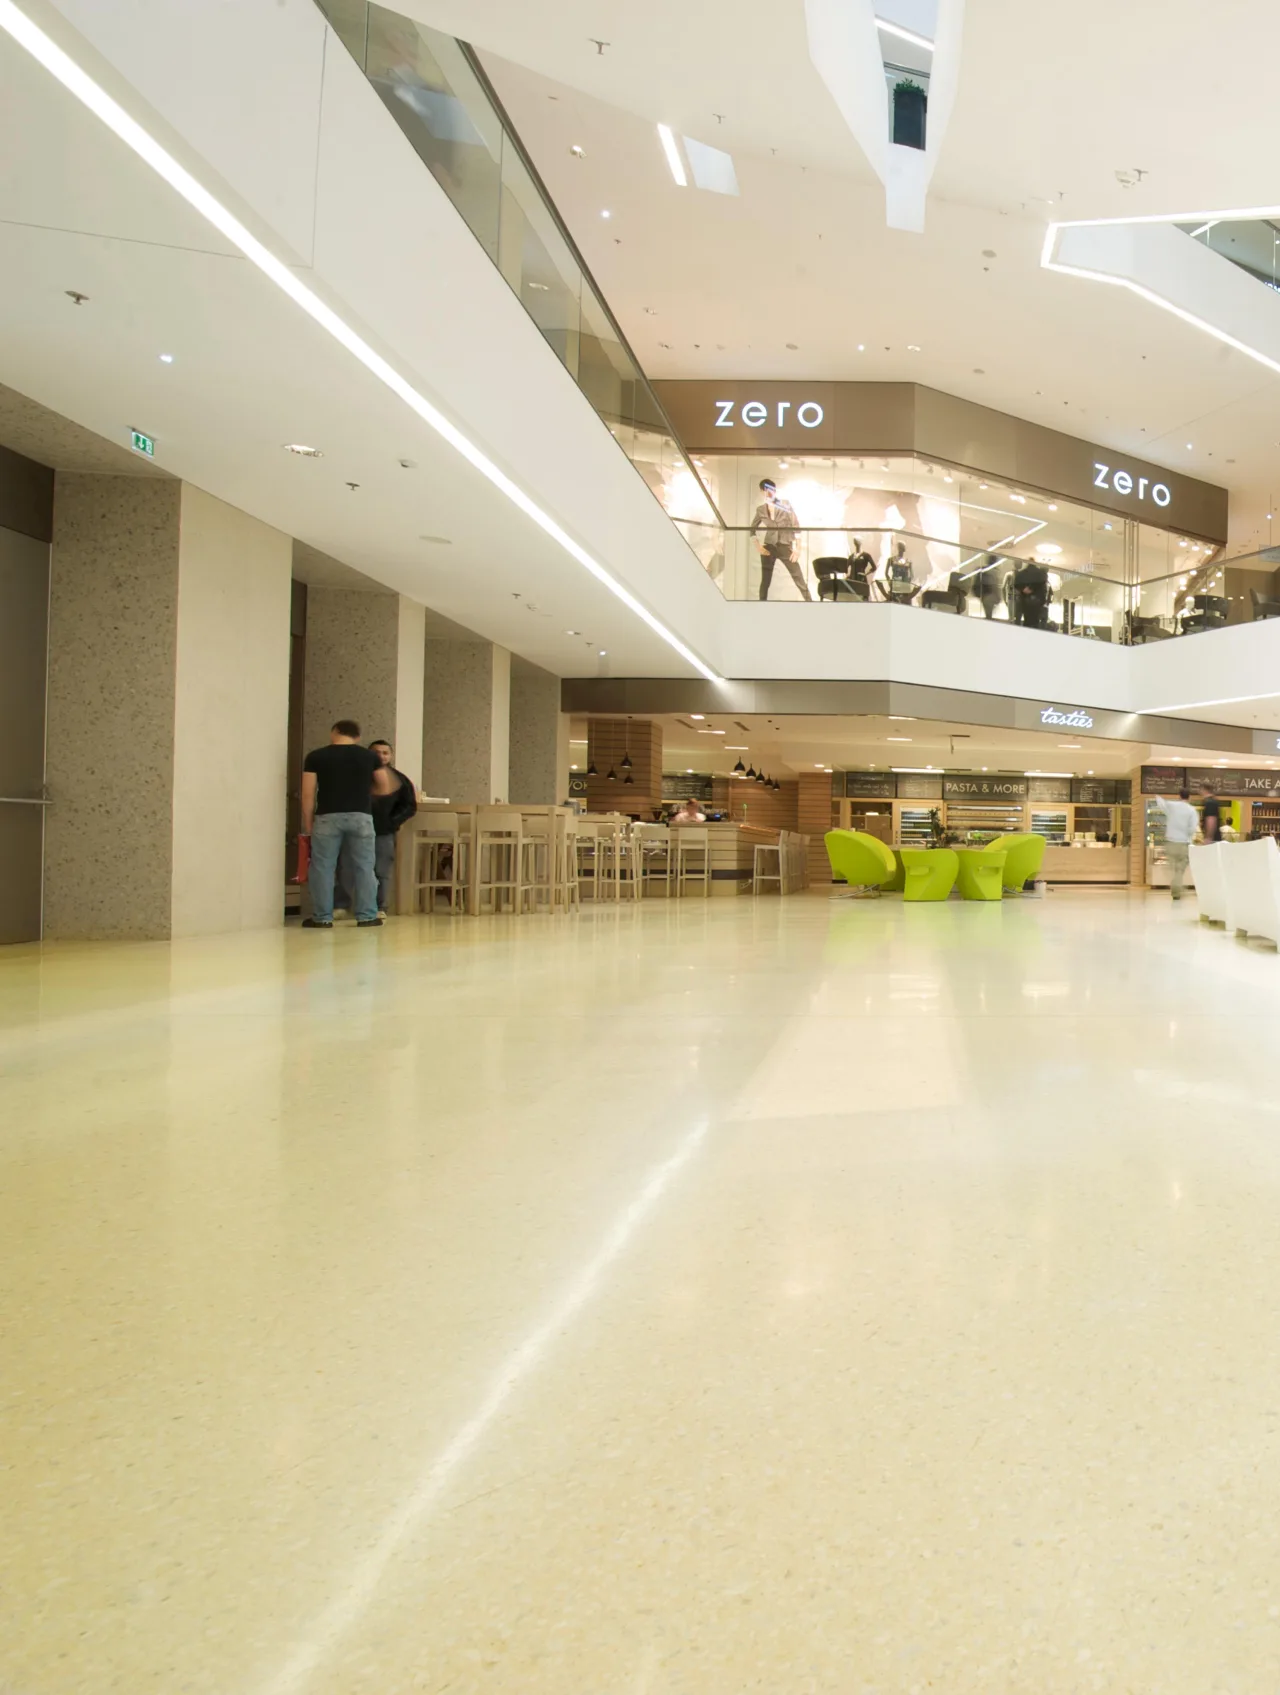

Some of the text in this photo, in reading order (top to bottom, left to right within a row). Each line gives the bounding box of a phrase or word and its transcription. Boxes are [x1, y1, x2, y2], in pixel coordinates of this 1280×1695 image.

[715, 401, 824, 428] zero
[1094, 463, 1171, 507] zero
[1040, 707, 1093, 728] tasties
[946, 783, 978, 793] PASTA
[981, 783, 989, 793] &
[992, 784, 1025, 794] MORE
[1245, 778, 1271, 789] TAKE
